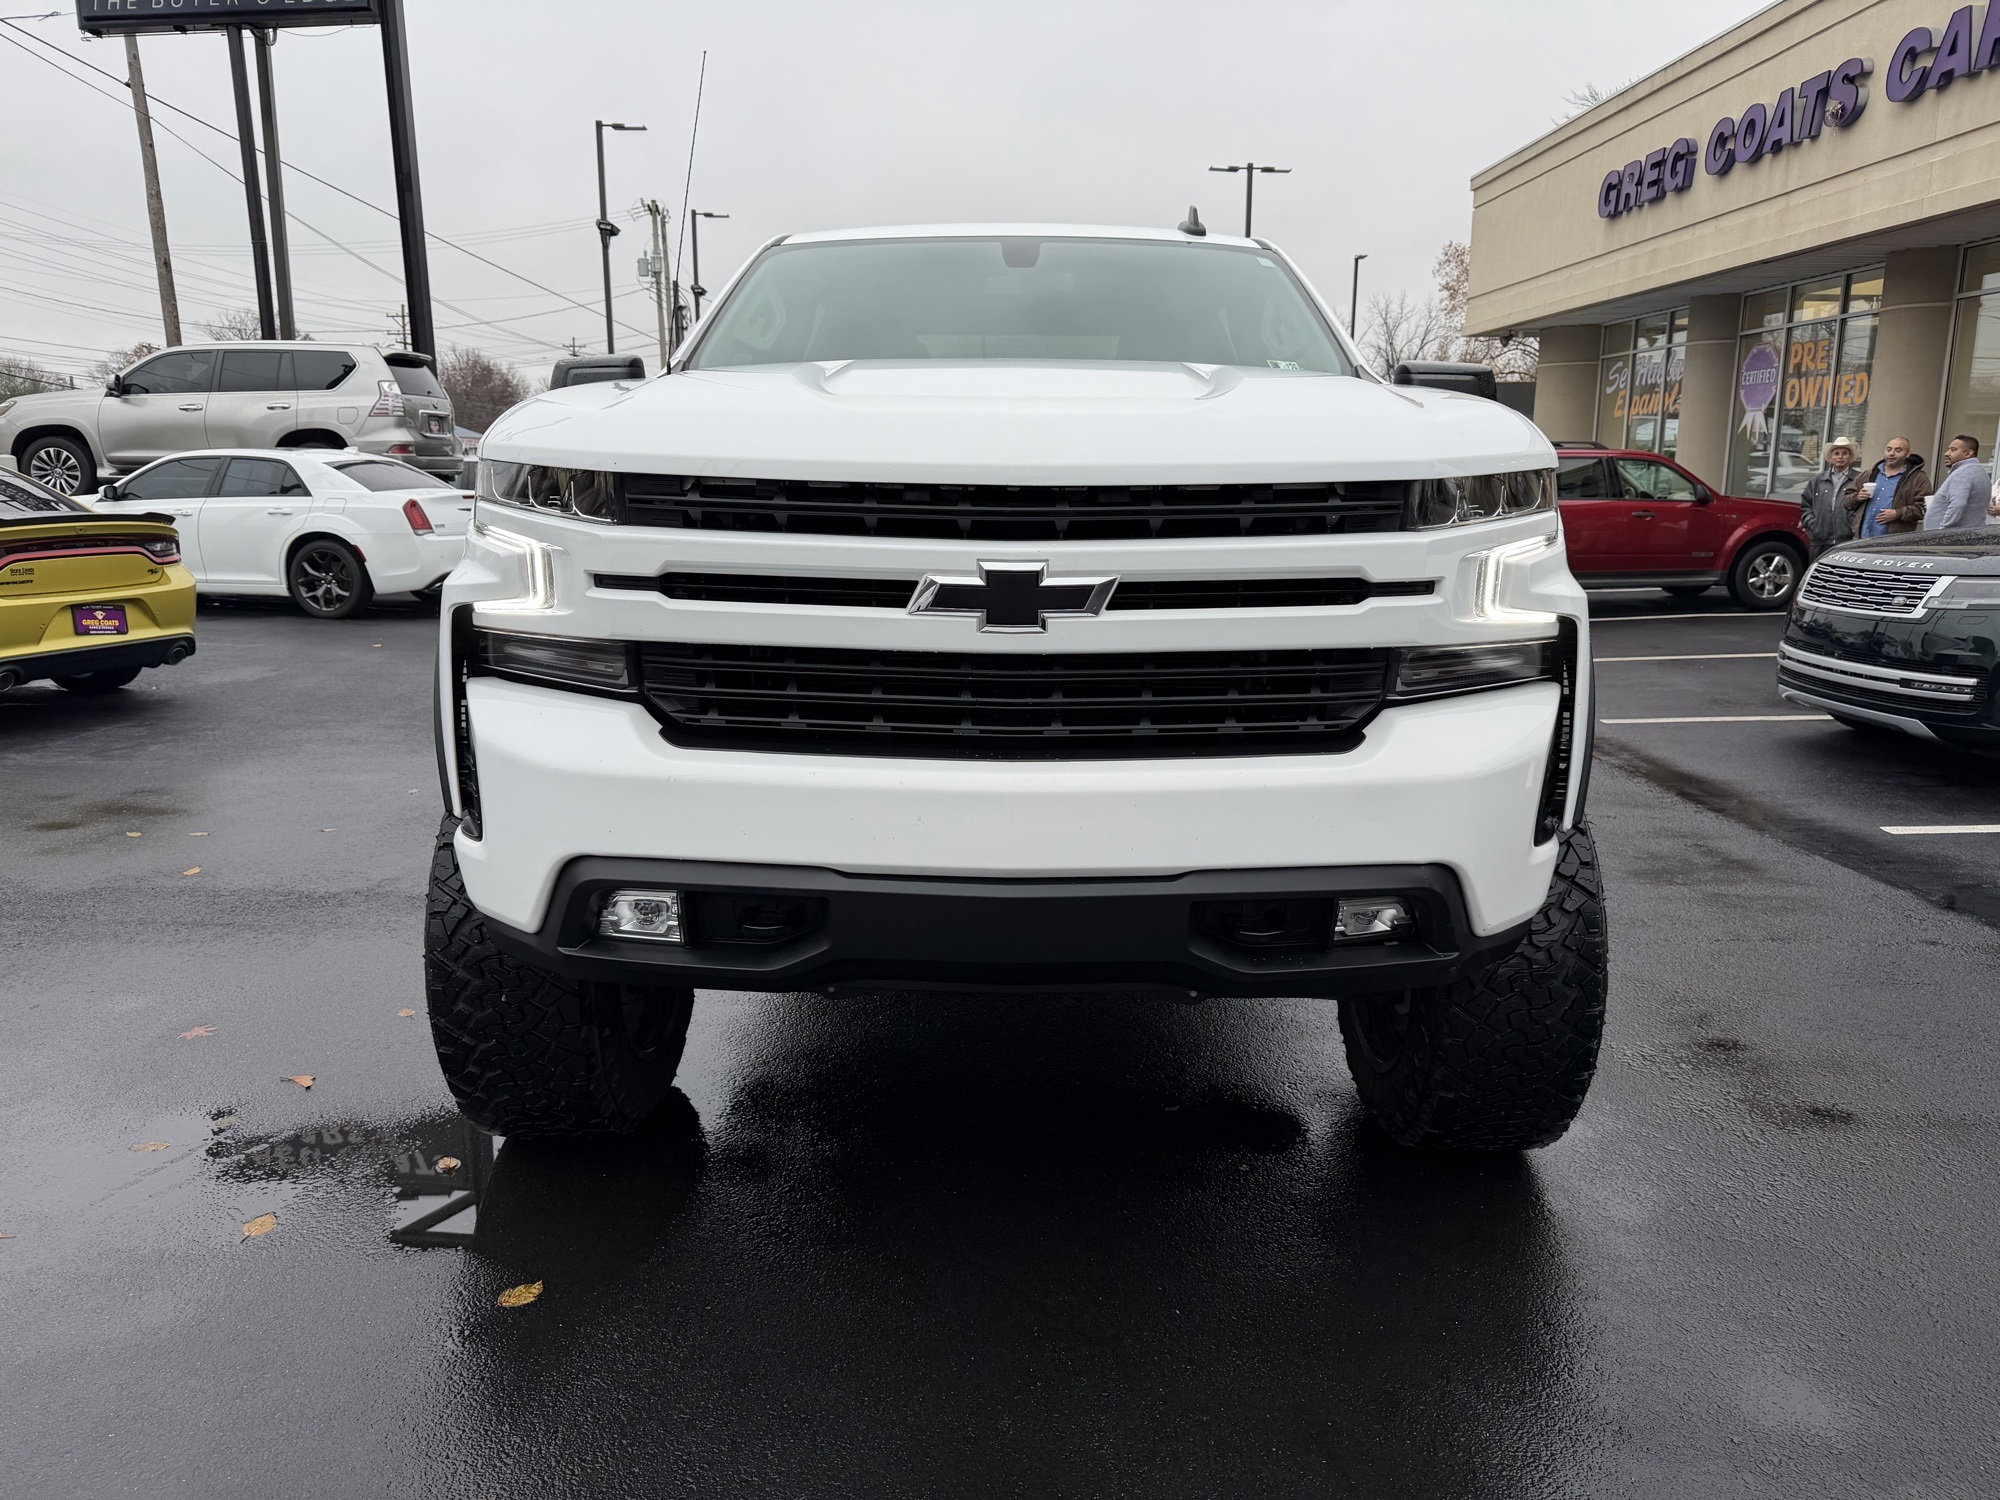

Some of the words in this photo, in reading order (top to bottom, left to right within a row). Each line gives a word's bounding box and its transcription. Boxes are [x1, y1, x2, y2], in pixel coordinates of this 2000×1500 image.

[1598, 137, 1698, 218] GREG
[1704, 57, 1875, 175] COATS
[1742, 368, 1776, 385] CERTIFIED
[1785, 372, 1869, 409] OWNED
[1827, 554, 1866, 564] RANGE
[1872, 559, 1934, 569] ROVER
